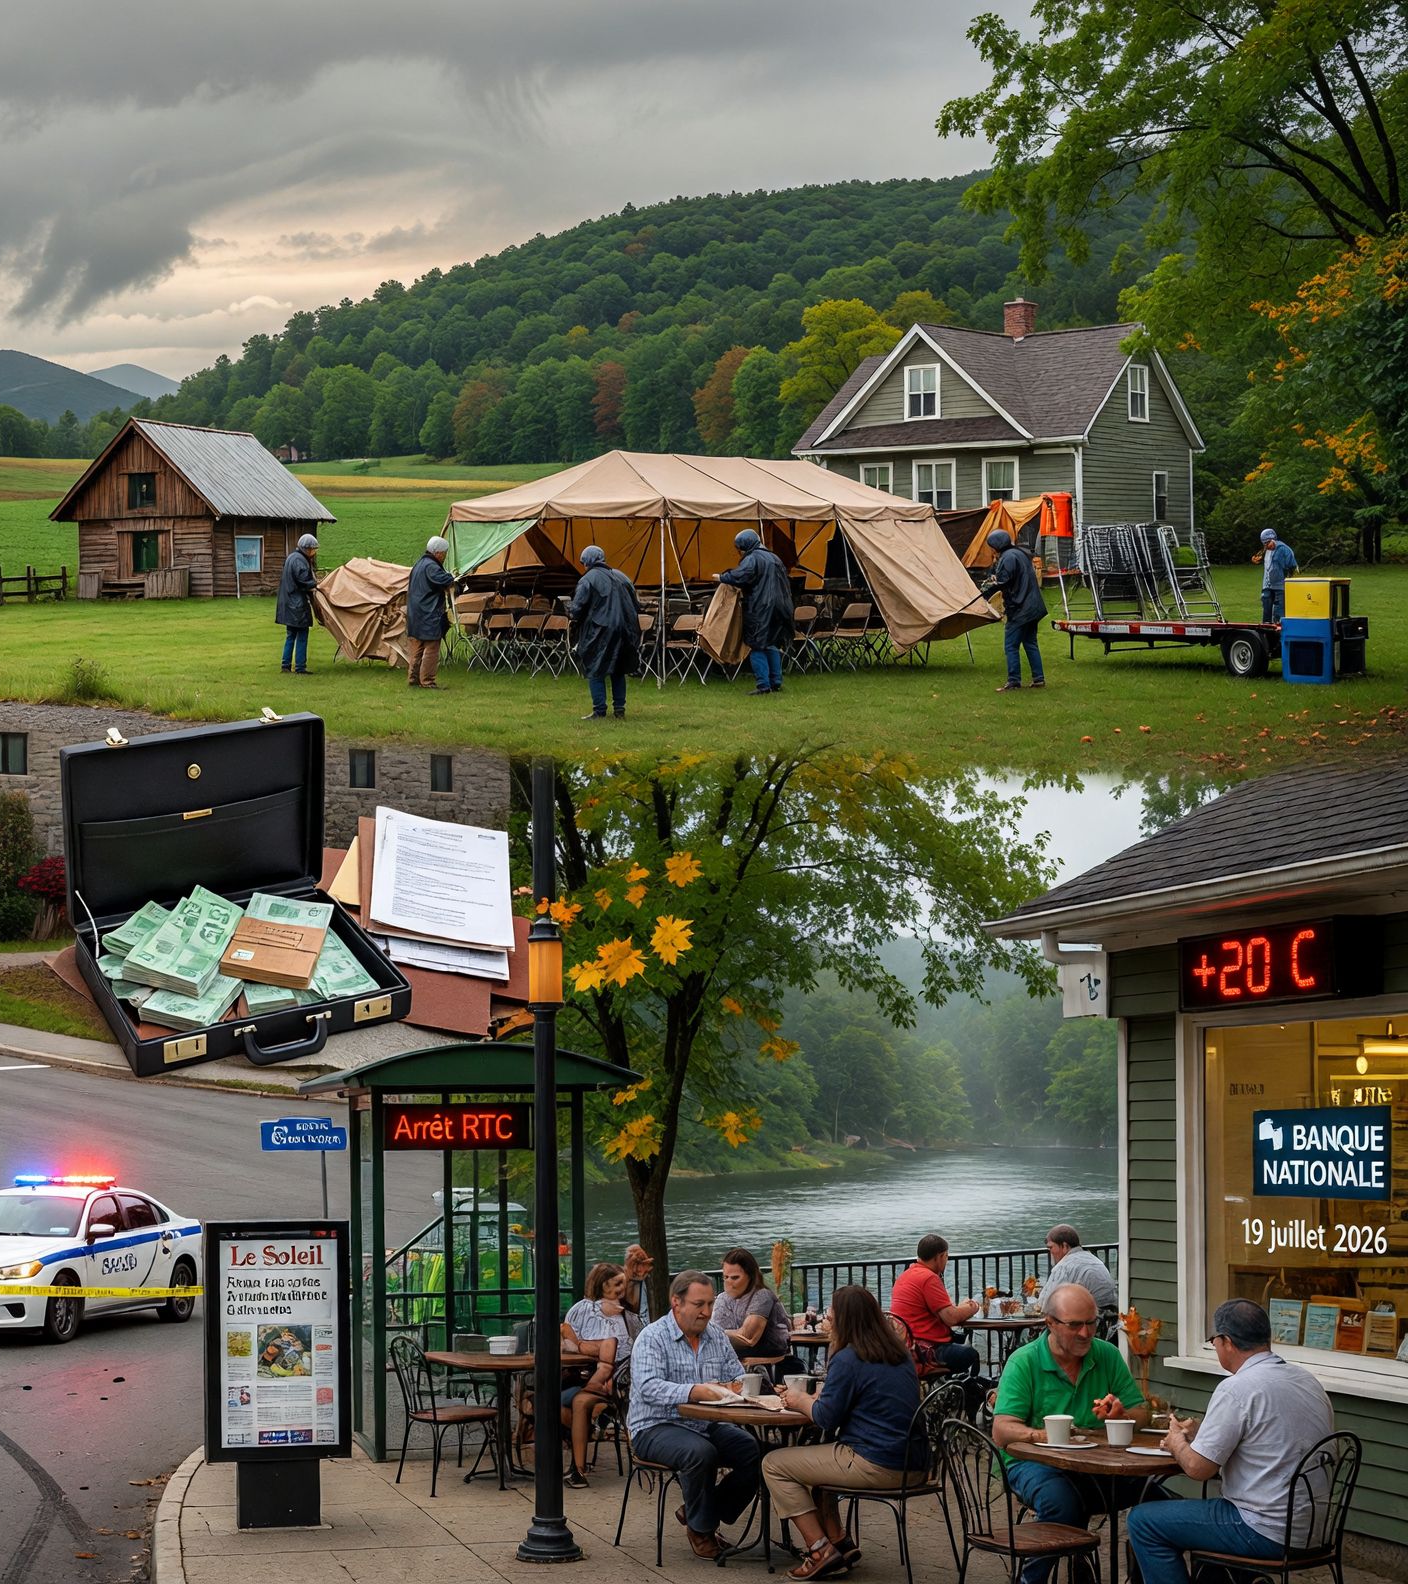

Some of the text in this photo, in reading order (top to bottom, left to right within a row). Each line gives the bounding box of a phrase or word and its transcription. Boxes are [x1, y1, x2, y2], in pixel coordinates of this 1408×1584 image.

[1192, 929, 1316, 996] +20 C
[394, 1113, 513, 1141] Arrêt RTC
[1292, 1124, 1385, 1156] BANQUE
[1263, 1159, 1385, 1189] NATIONALE
[1241, 1217, 1388, 1255] 19 juillet 2026
[230, 1245, 324, 1267] Le Soleil
